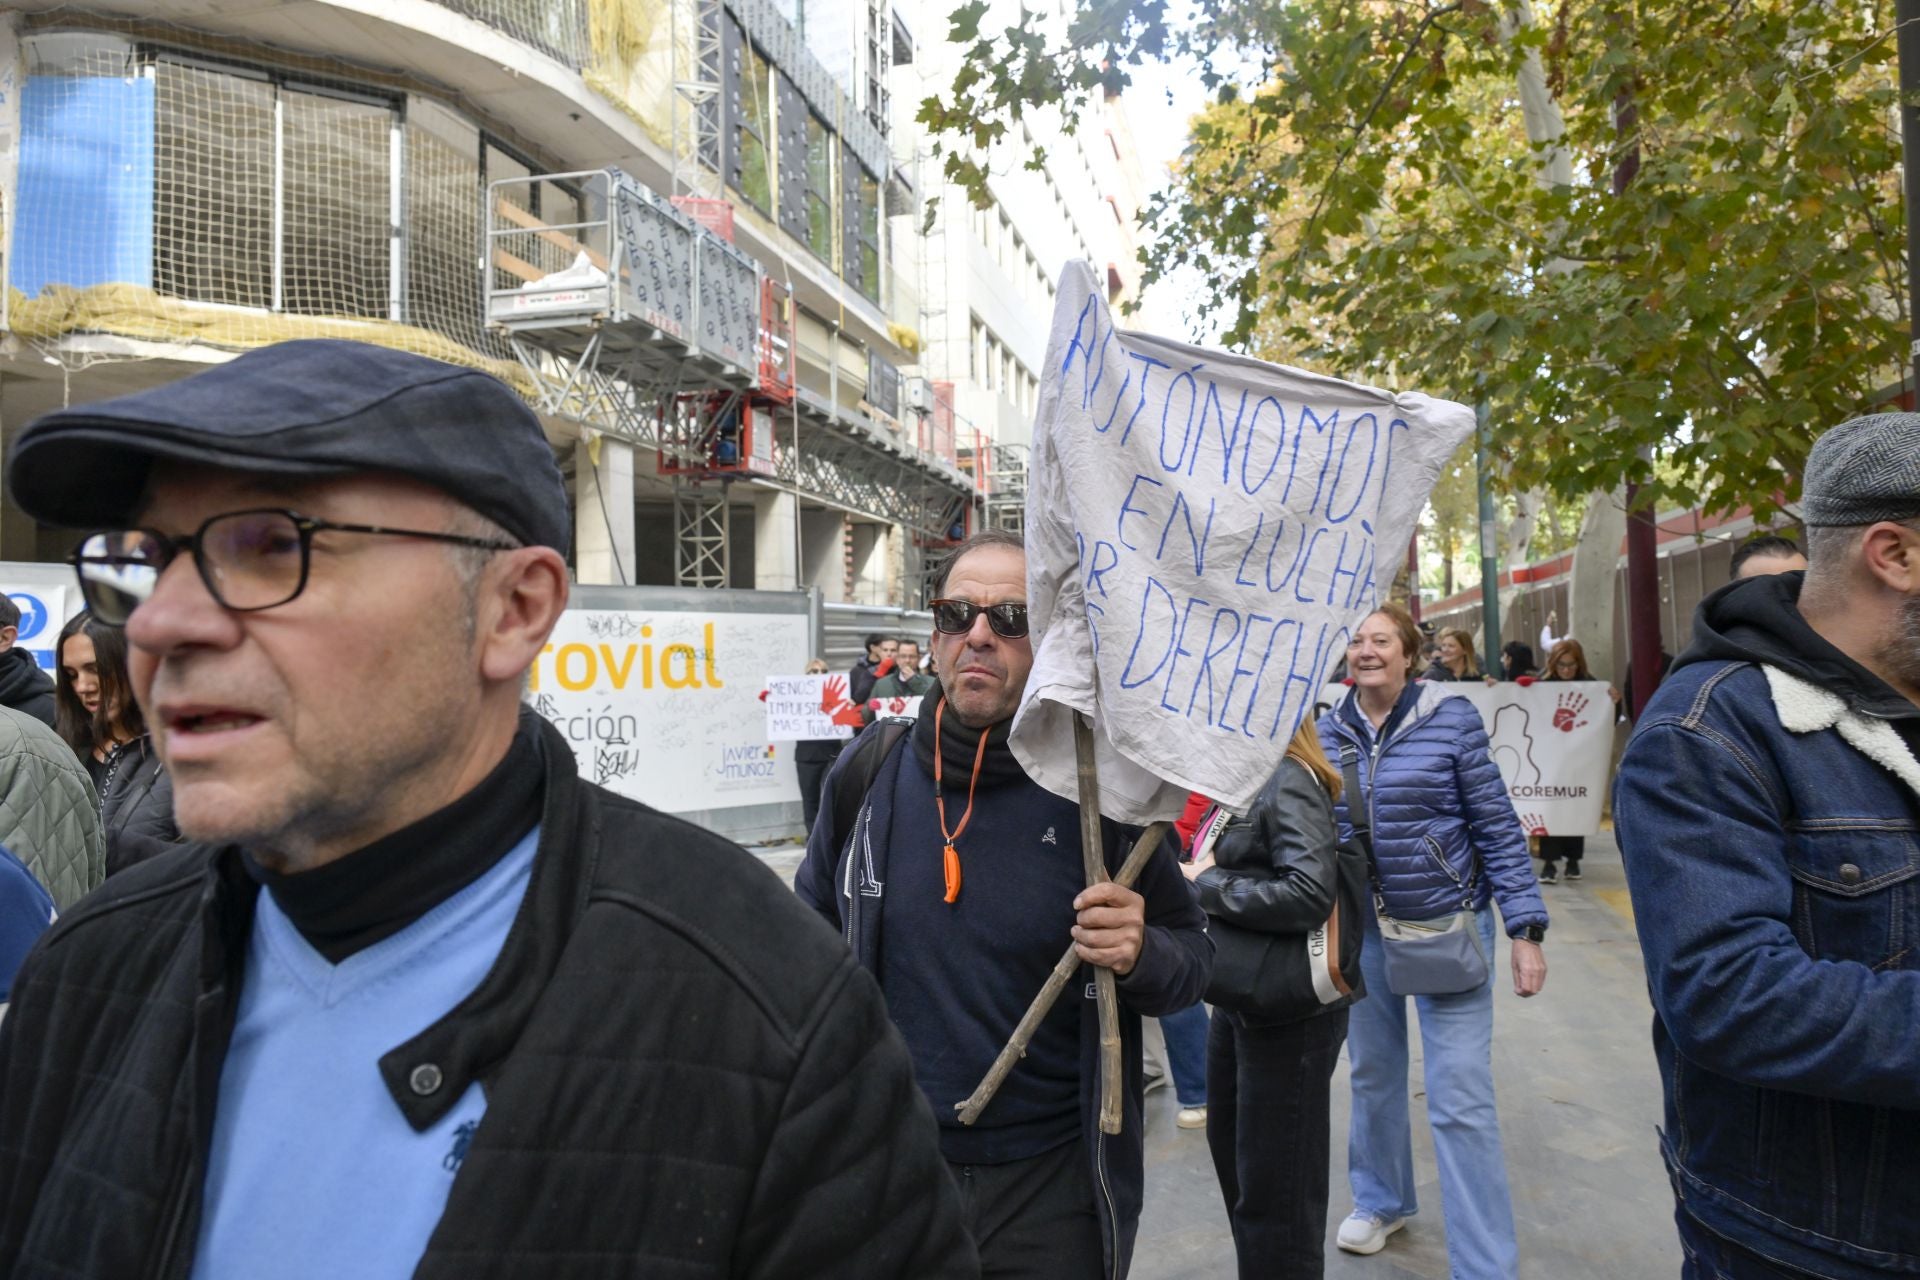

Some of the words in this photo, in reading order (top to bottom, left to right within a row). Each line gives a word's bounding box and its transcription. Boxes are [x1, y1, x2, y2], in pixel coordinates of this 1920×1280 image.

[1117, 474, 1217, 577] EN
[769, 680, 816, 697] MENOS
[1511, 785, 1588, 798] COREMUR
